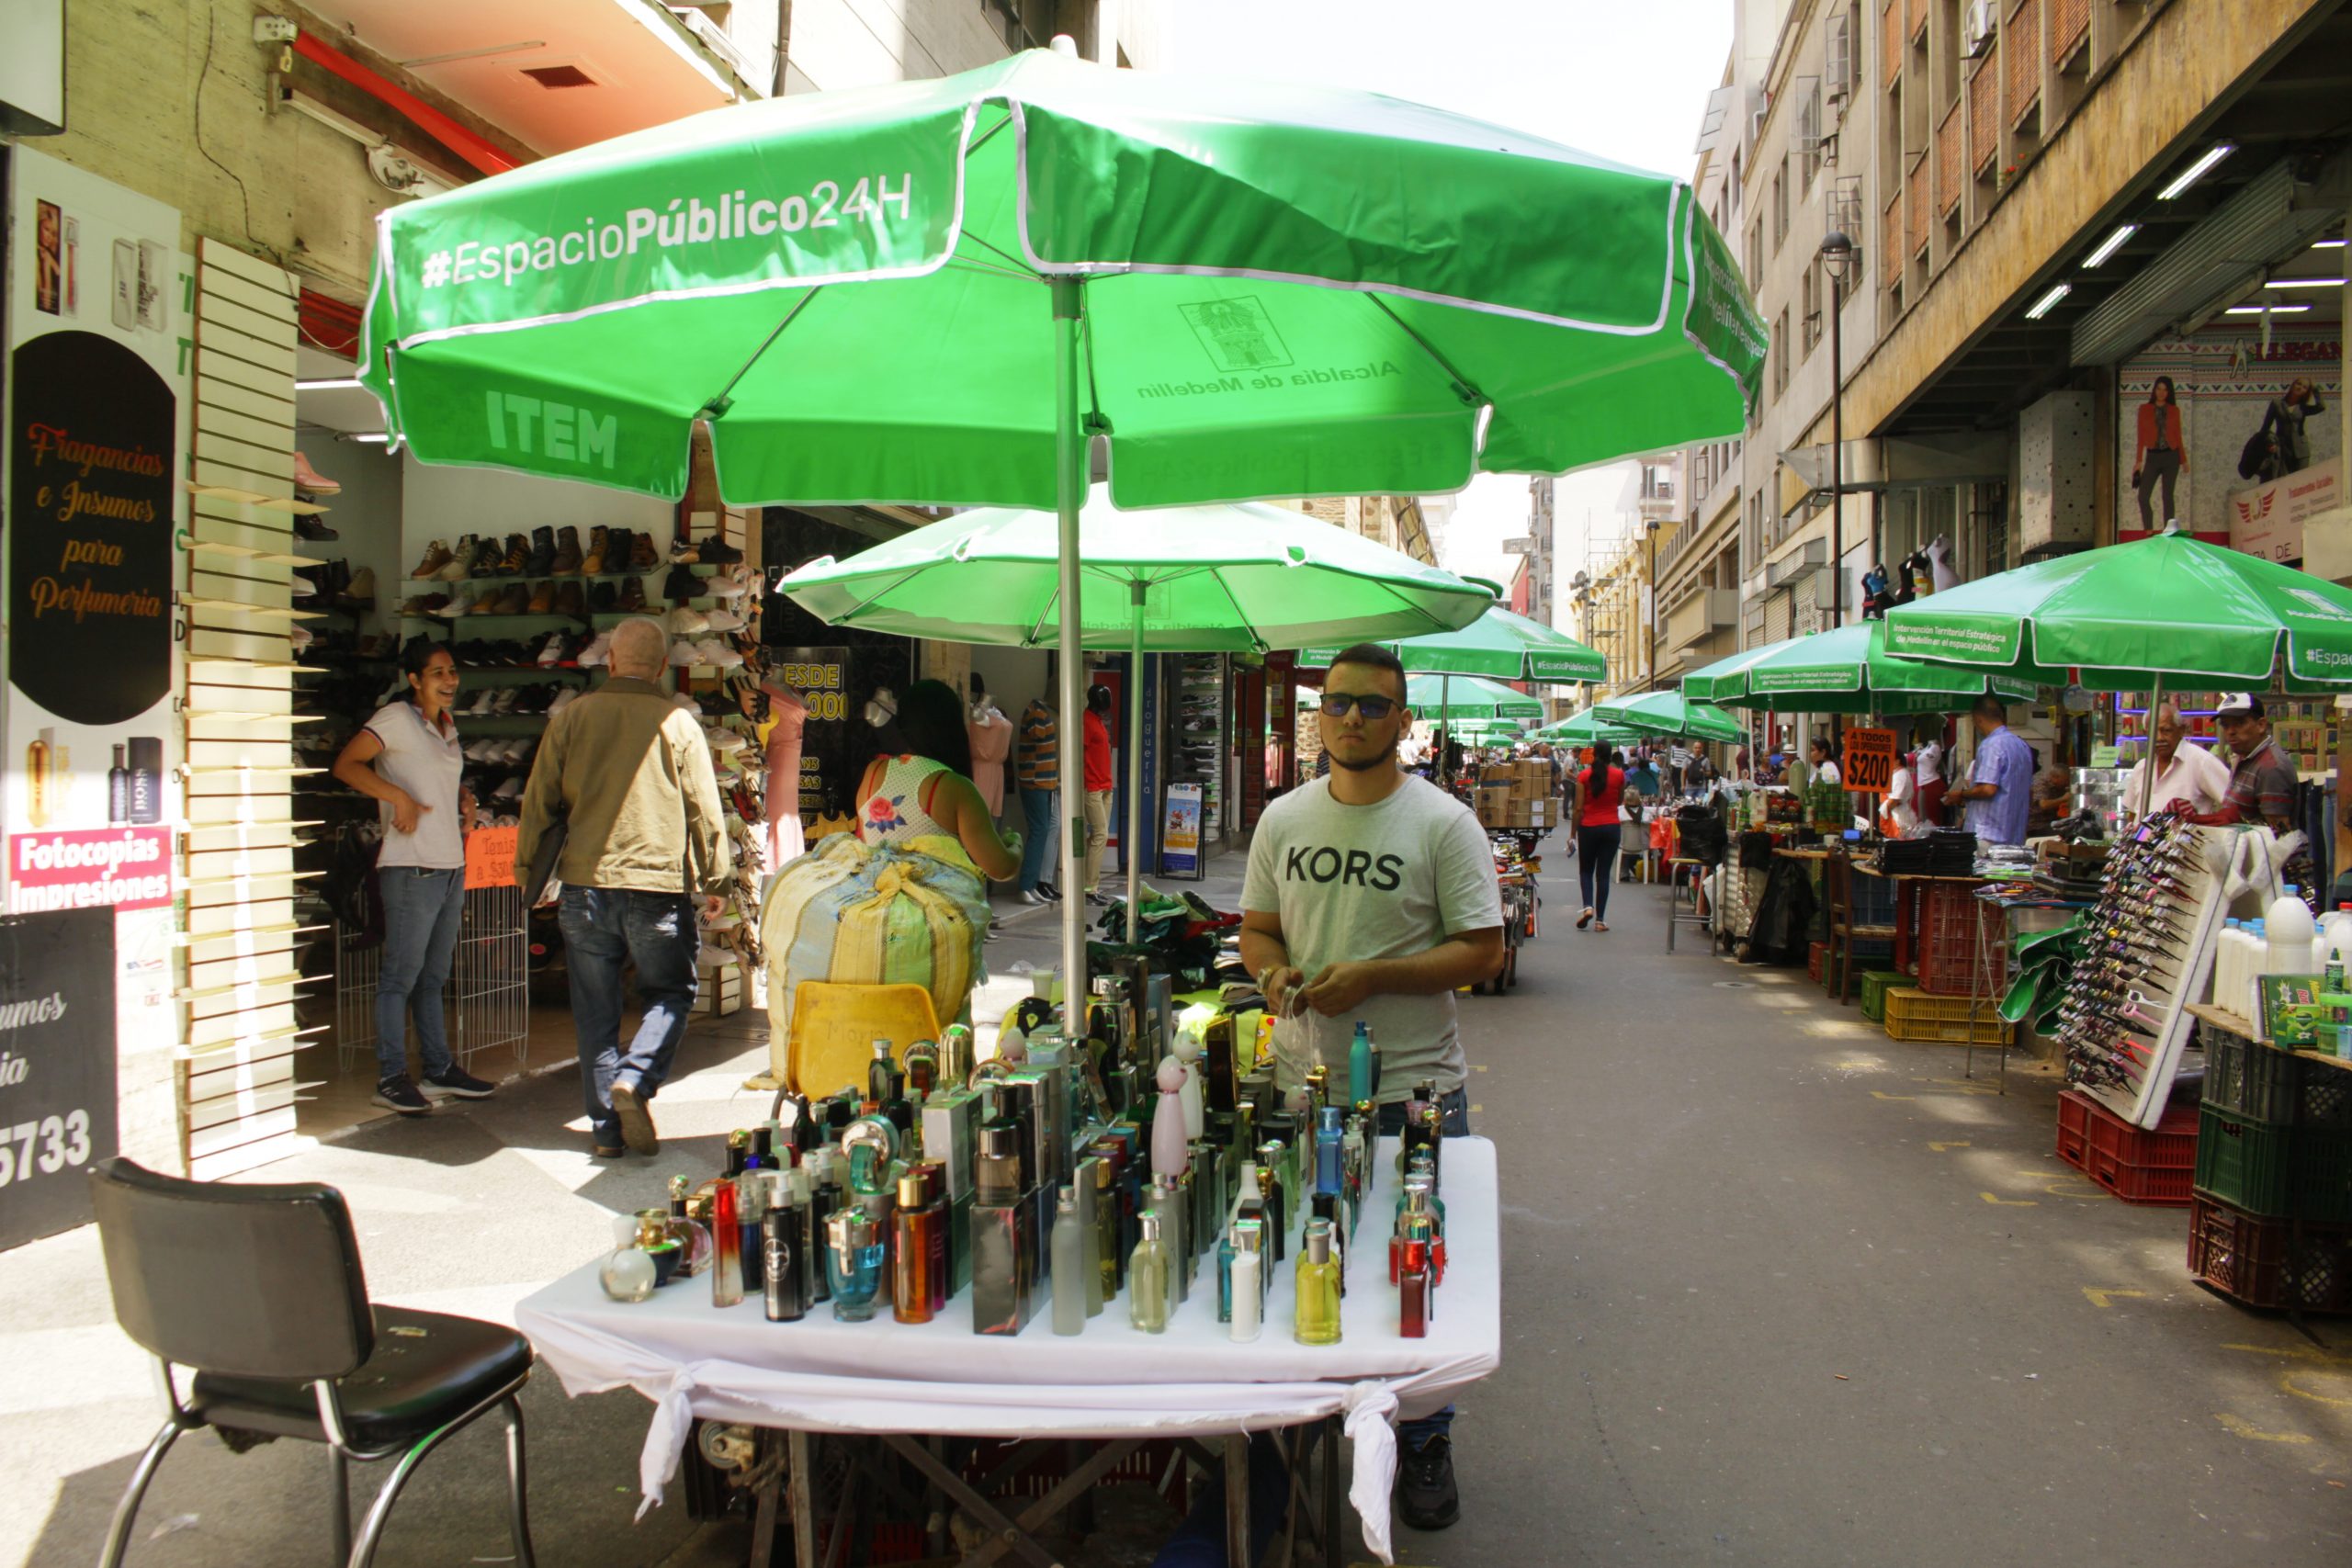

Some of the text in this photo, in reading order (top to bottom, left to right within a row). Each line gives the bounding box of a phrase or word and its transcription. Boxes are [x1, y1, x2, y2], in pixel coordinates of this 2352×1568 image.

[420, 173, 912, 289] #EspacioPúblico24H
[486, 390, 617, 469] ITEM
[28, 423, 164, 477] Fragancias
[37, 479, 156, 522] e Insumos
[60, 538, 125, 573] para
[2275, 542, 2292, 559] DE
[1893, 624, 2007, 643] Intervención Territorial Estratégica
[1895, 635, 1906, 644] de
[1949, 639, 1973, 650] espacio
[1973, 641, 2001, 654] público
[784, 663, 842, 689] ESDE
[1906, 694, 1953, 709] ITEM
[1860, 732, 1891, 743] TODOS
[1848, 751, 1890, 788] $200
[19, 829, 160, 873] Fotocopias
[1285, 845, 1405, 891] KORS
[9, 870, 168, 915] Impresiones
